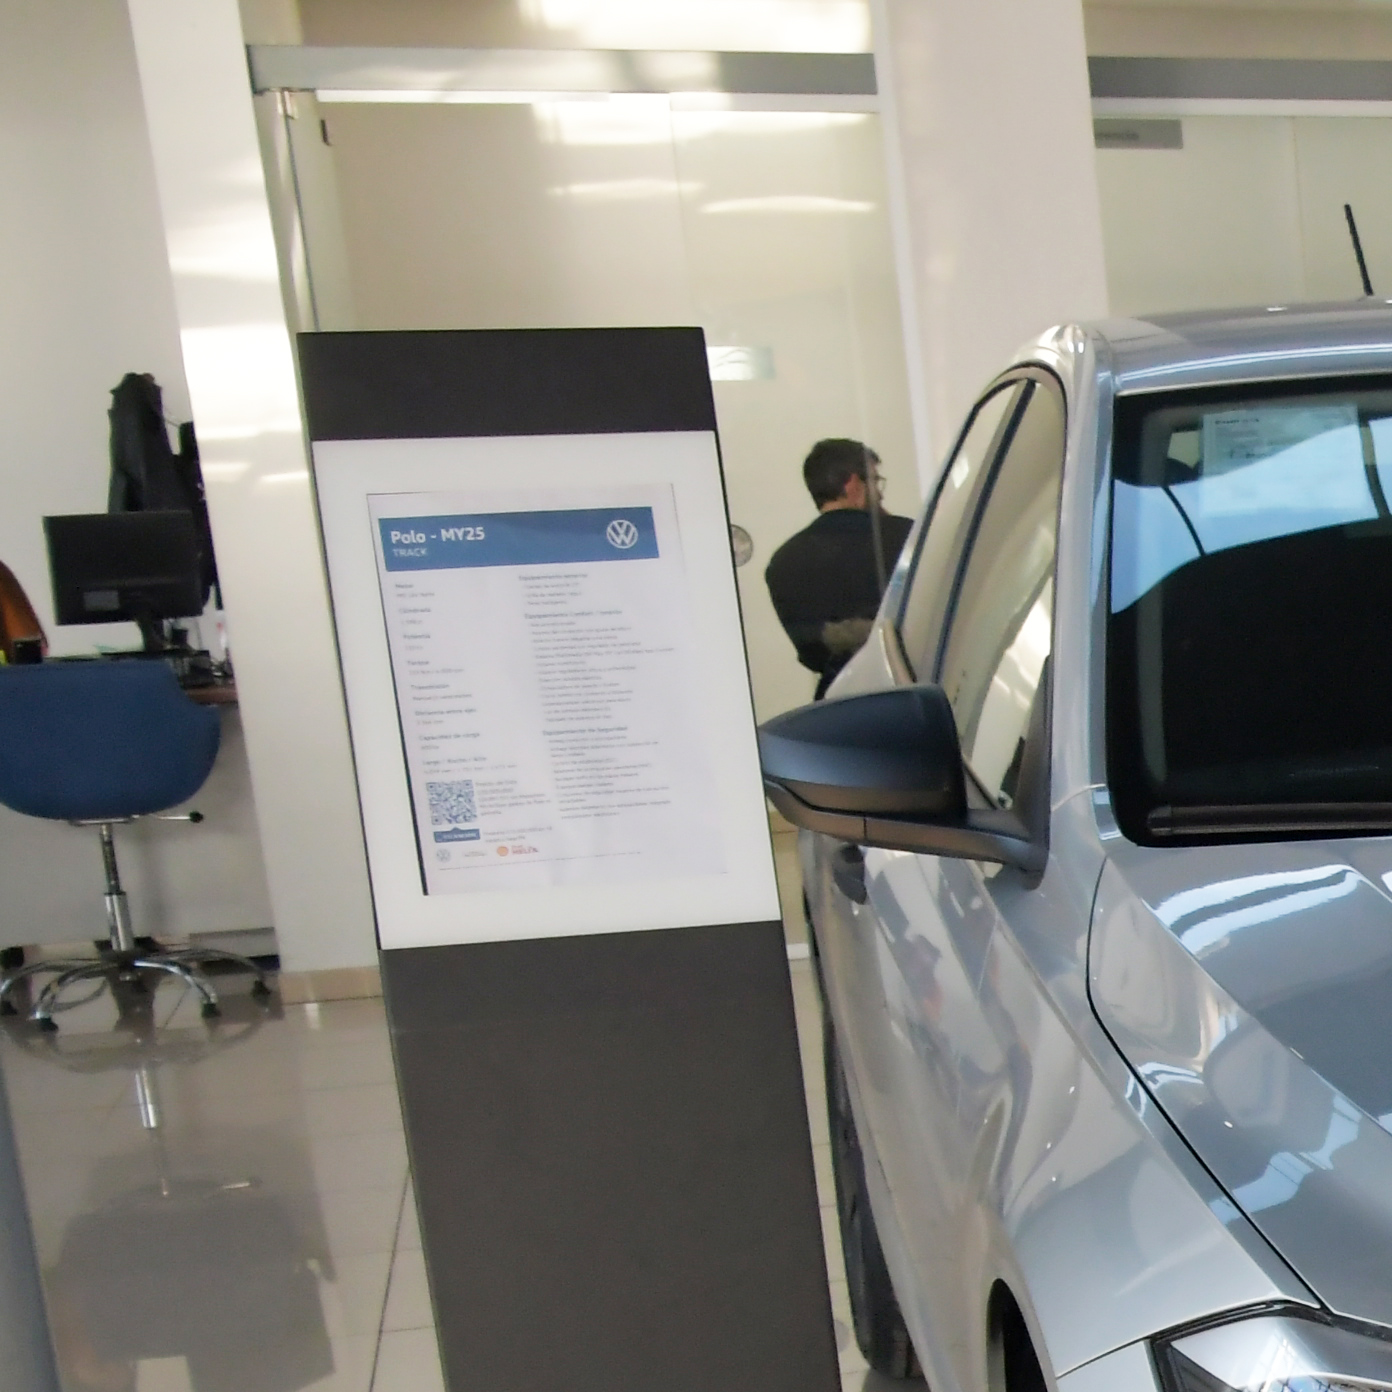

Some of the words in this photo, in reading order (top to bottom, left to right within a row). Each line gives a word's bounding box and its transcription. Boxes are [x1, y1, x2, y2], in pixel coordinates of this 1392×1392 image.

[390, 529, 426, 545] Polo
[440, 526, 486, 542] MY25
[392, 547, 428, 557] TRACK
